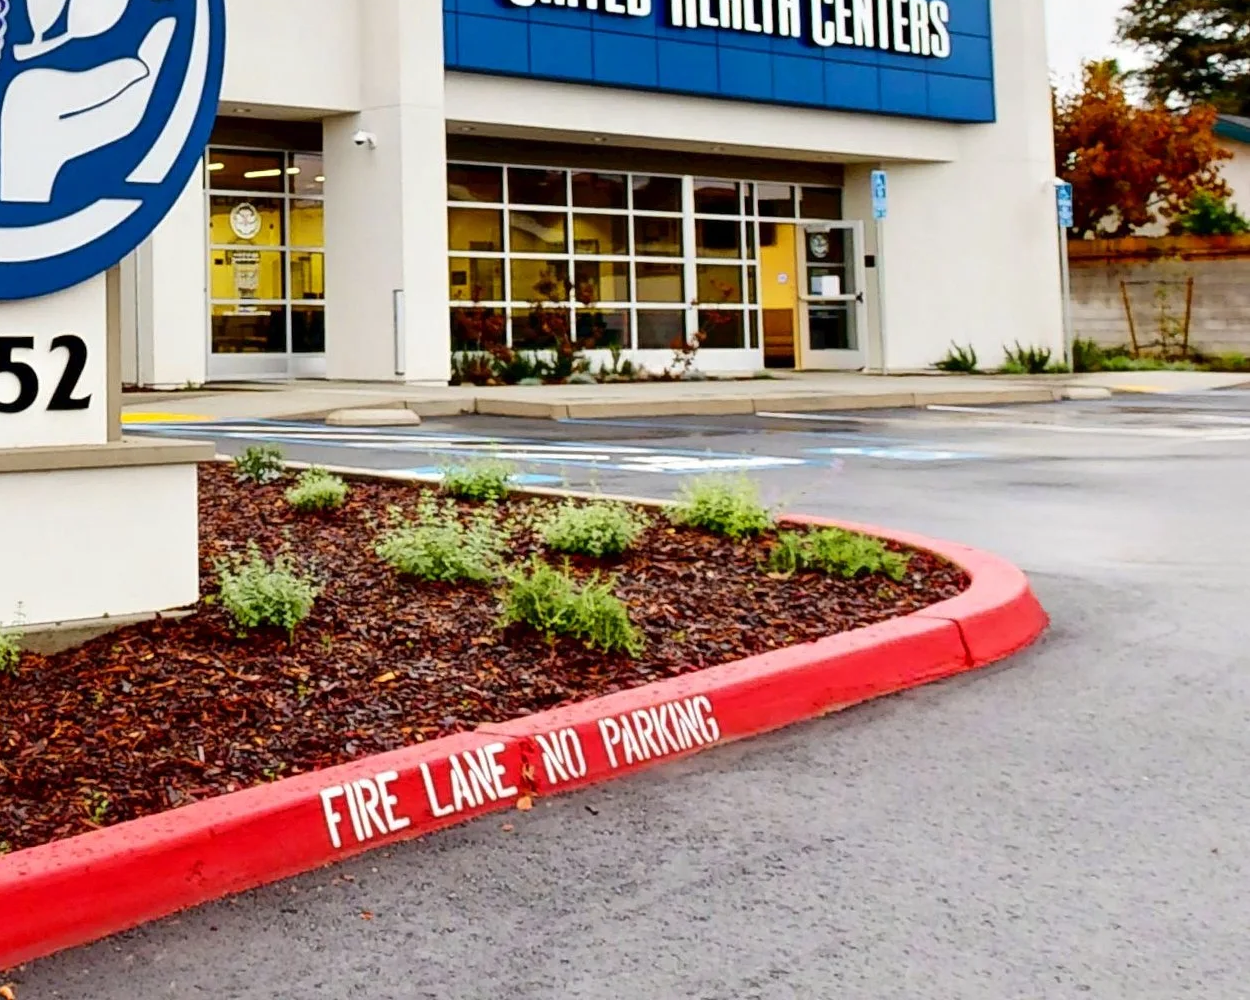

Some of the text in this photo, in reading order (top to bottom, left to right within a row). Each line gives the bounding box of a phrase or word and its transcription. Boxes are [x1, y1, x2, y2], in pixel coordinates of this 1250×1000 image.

[318, 694, 720, 848] FIRE LANE NO PARKING
